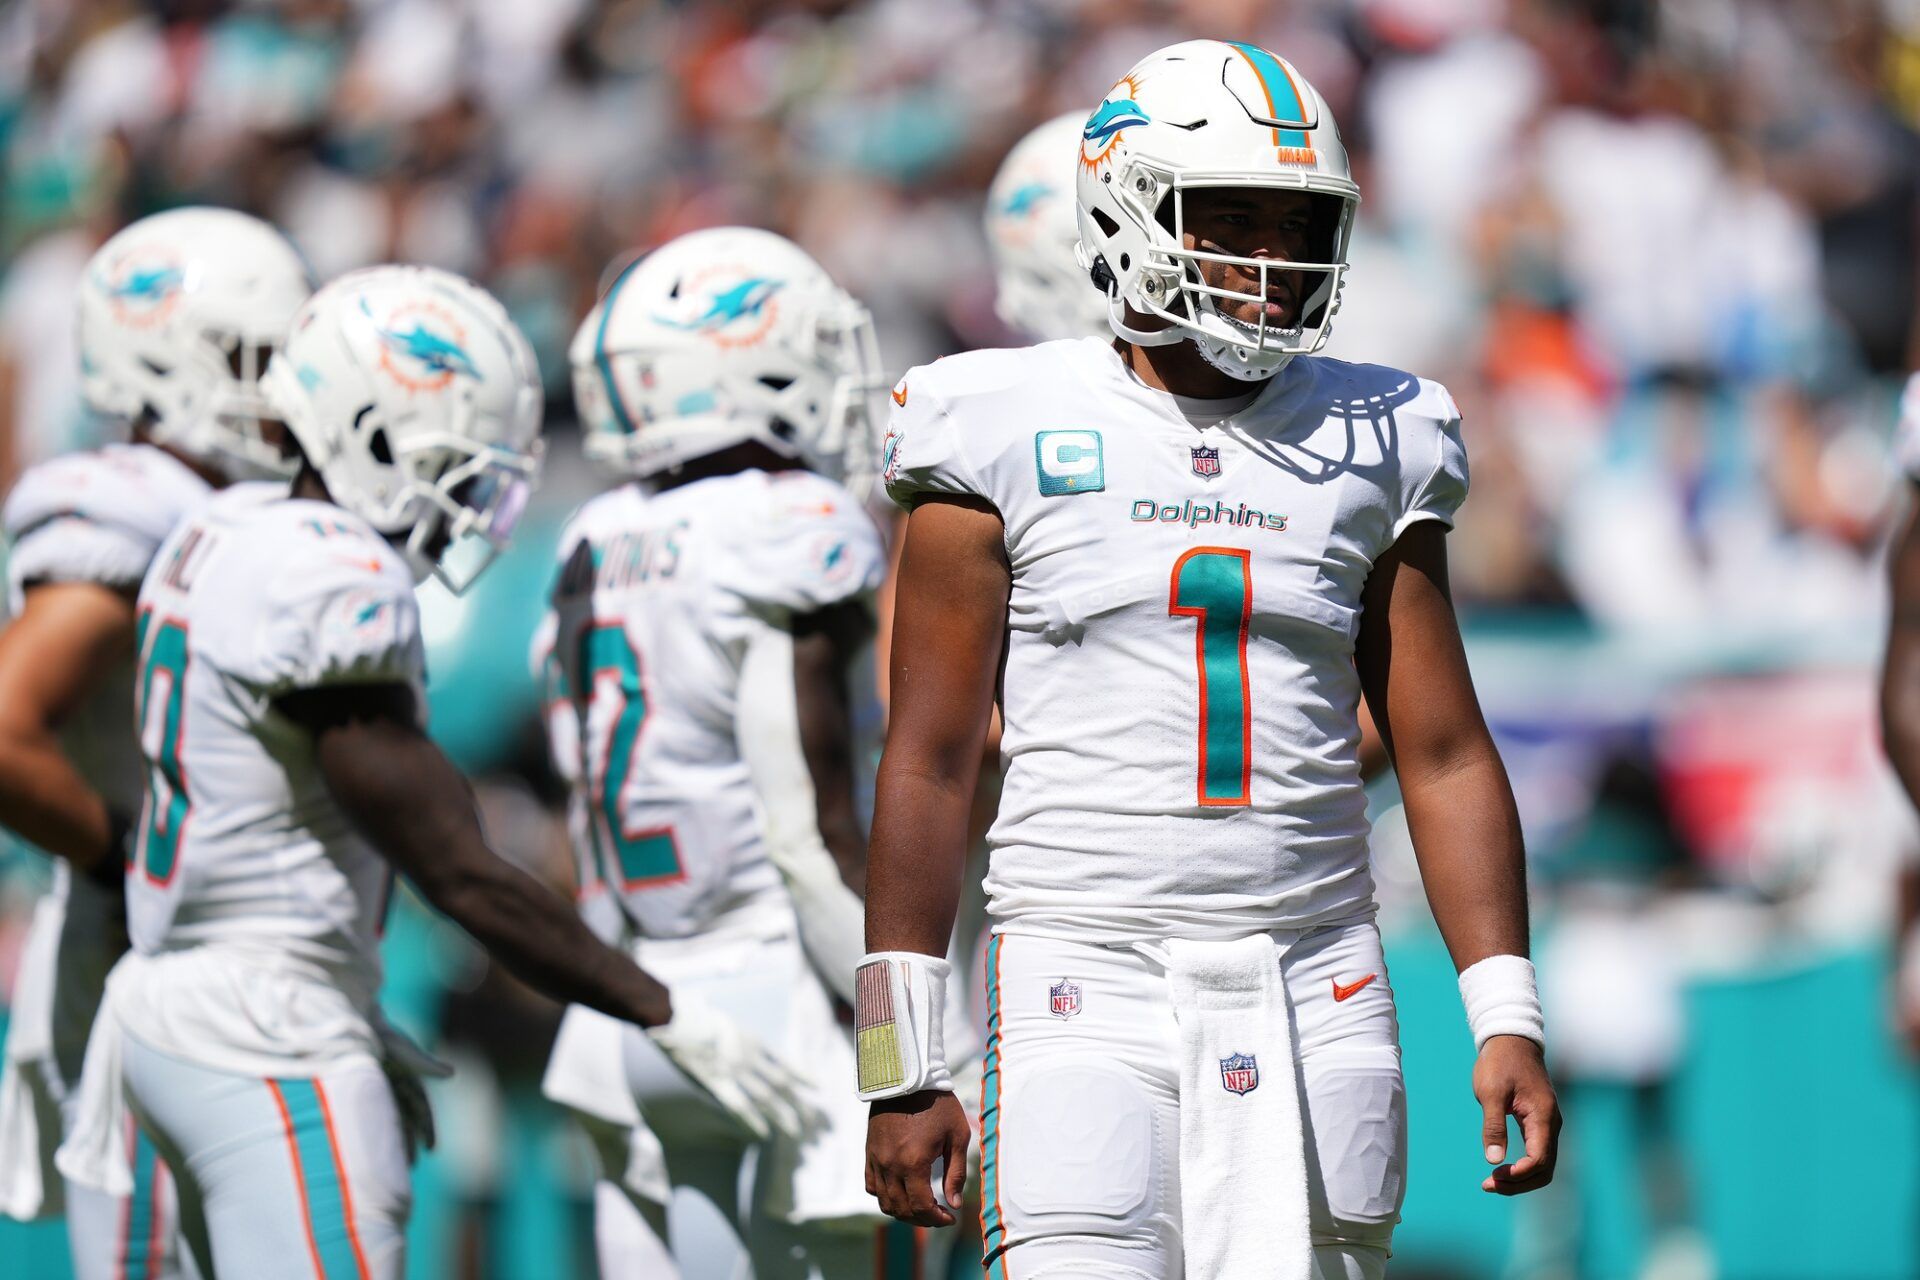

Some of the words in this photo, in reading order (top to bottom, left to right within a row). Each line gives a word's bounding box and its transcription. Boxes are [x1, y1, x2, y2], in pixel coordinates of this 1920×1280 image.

[1277, 148, 1316, 166] MIAMI
[1041, 432, 1099, 477] C
[1194, 459, 1218, 474] NFL
[1130, 498, 1289, 532] Dolphins
[1168, 545, 1253, 807] 1
[126, 603, 191, 890] 0
[1053, 996, 1077, 1012] NFL
[1224, 1069, 1256, 1091] NFL
